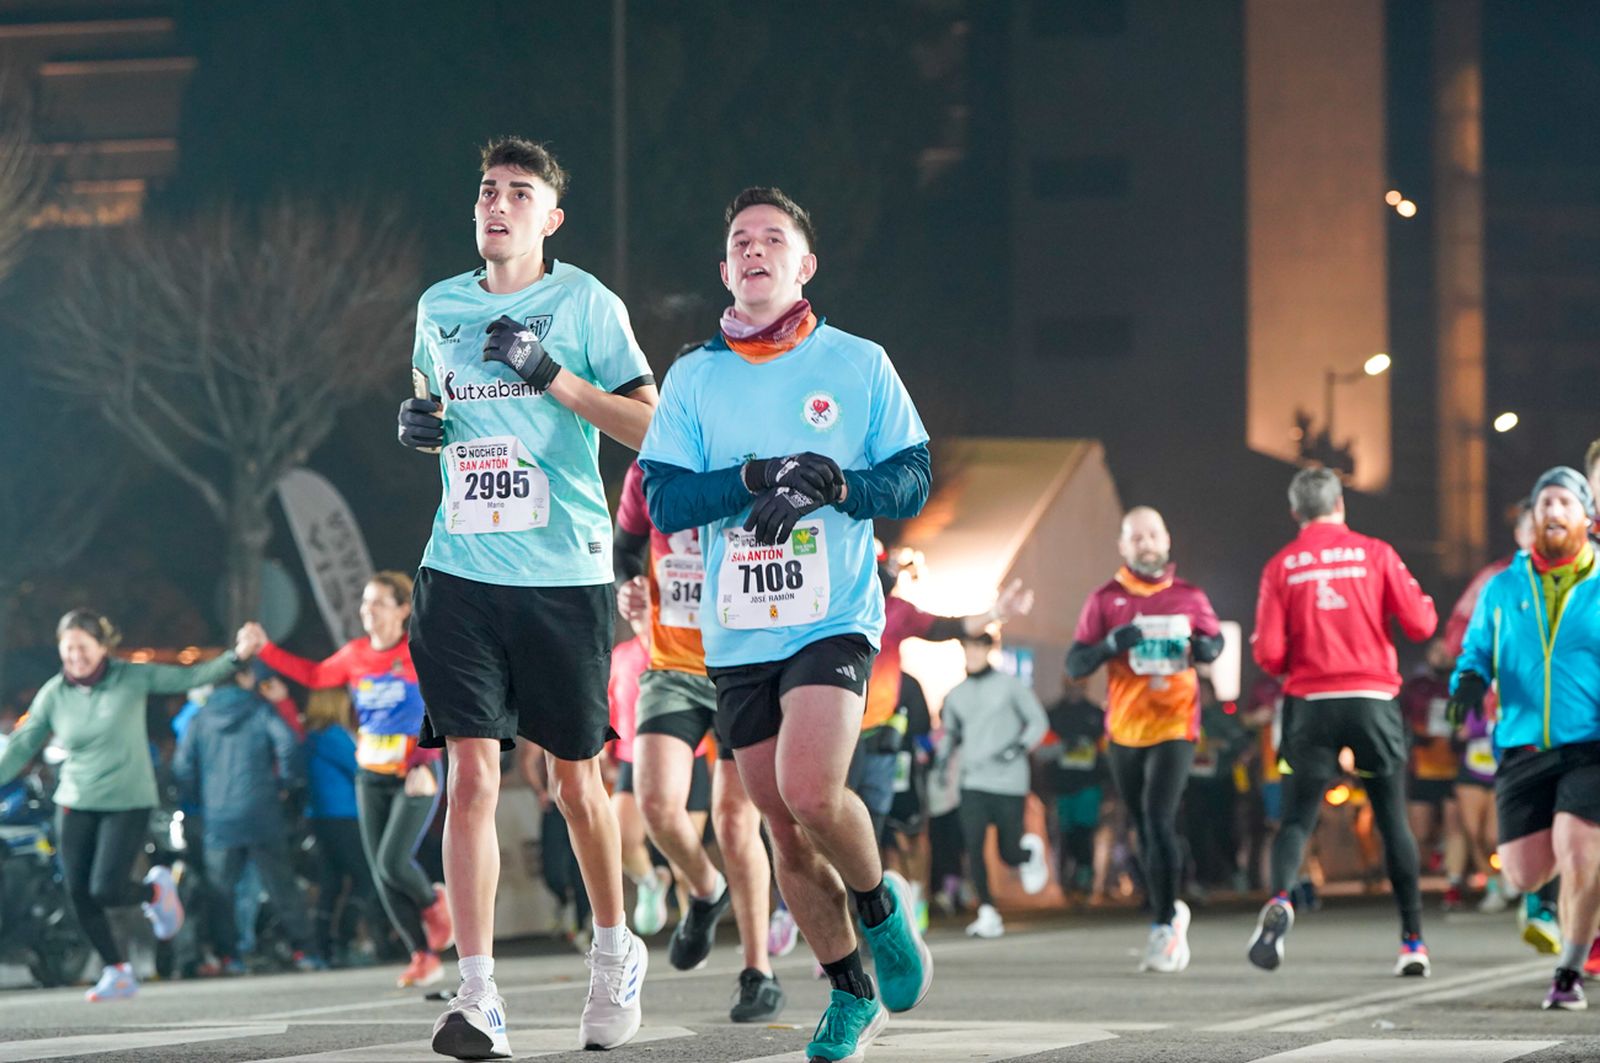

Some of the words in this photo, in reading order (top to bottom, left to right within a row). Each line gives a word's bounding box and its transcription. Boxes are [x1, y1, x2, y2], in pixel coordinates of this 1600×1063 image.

[469, 448, 495, 458] NOCHE
[496, 447, 508, 456] DE
[460, 461, 477, 471] SAN
[478, 457, 508, 470] ANTÓN
[464, 470, 530, 500] 2995
[487, 501, 504, 509] Mario
[747, 545, 783, 561] ANTÓN
[738, 560, 804, 593] 7108
[672, 581, 702, 603] 314
[750, 594, 766, 604] JOSÉ
[769, 592, 795, 602] RAMÓN
